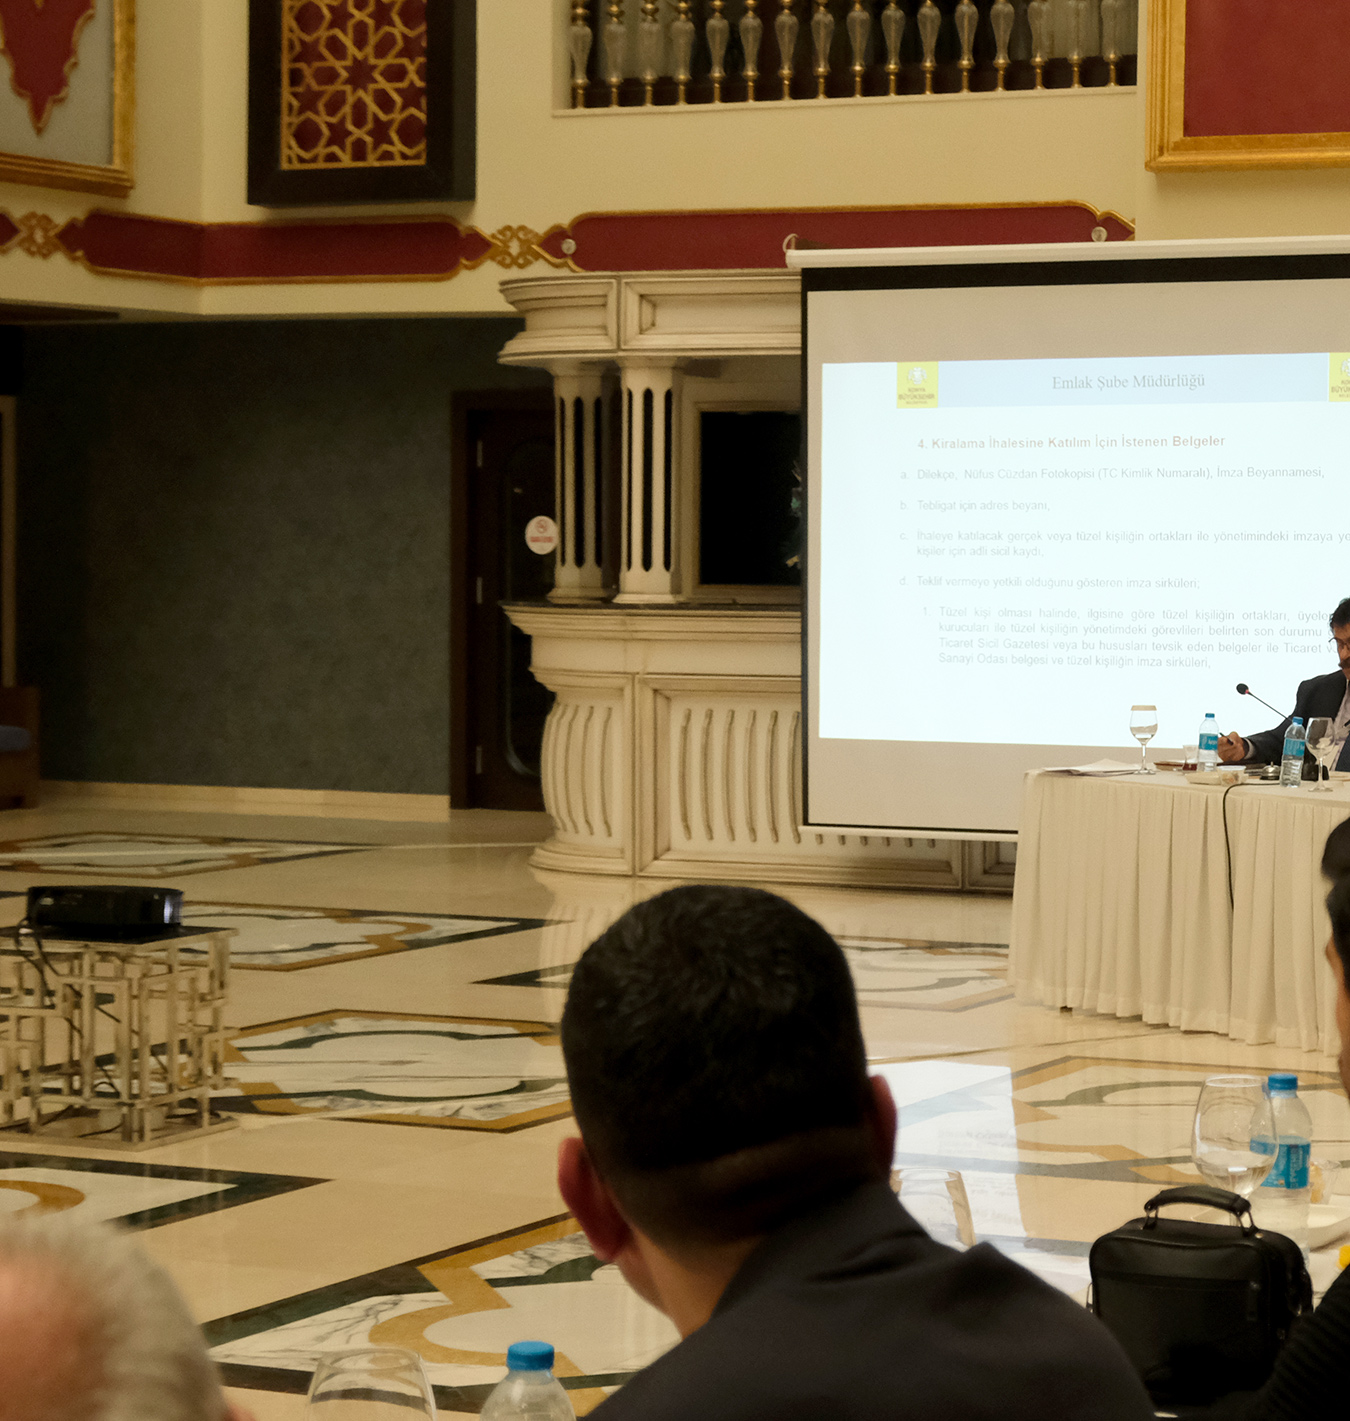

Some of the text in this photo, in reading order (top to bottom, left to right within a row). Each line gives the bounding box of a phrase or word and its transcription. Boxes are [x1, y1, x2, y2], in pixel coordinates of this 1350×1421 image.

[1053, 374, 1205, 393] Emlak Şube Müdürlüğü
[932, 437, 985, 449] Kiralama
[989, 435, 1043, 448] İhalesine
[1049, 436, 1090, 448] Katılım
[1096, 434, 1117, 450] İçin
[1122, 433, 1167, 447] İstenen
[1173, 434, 1225, 449] Belgeler
